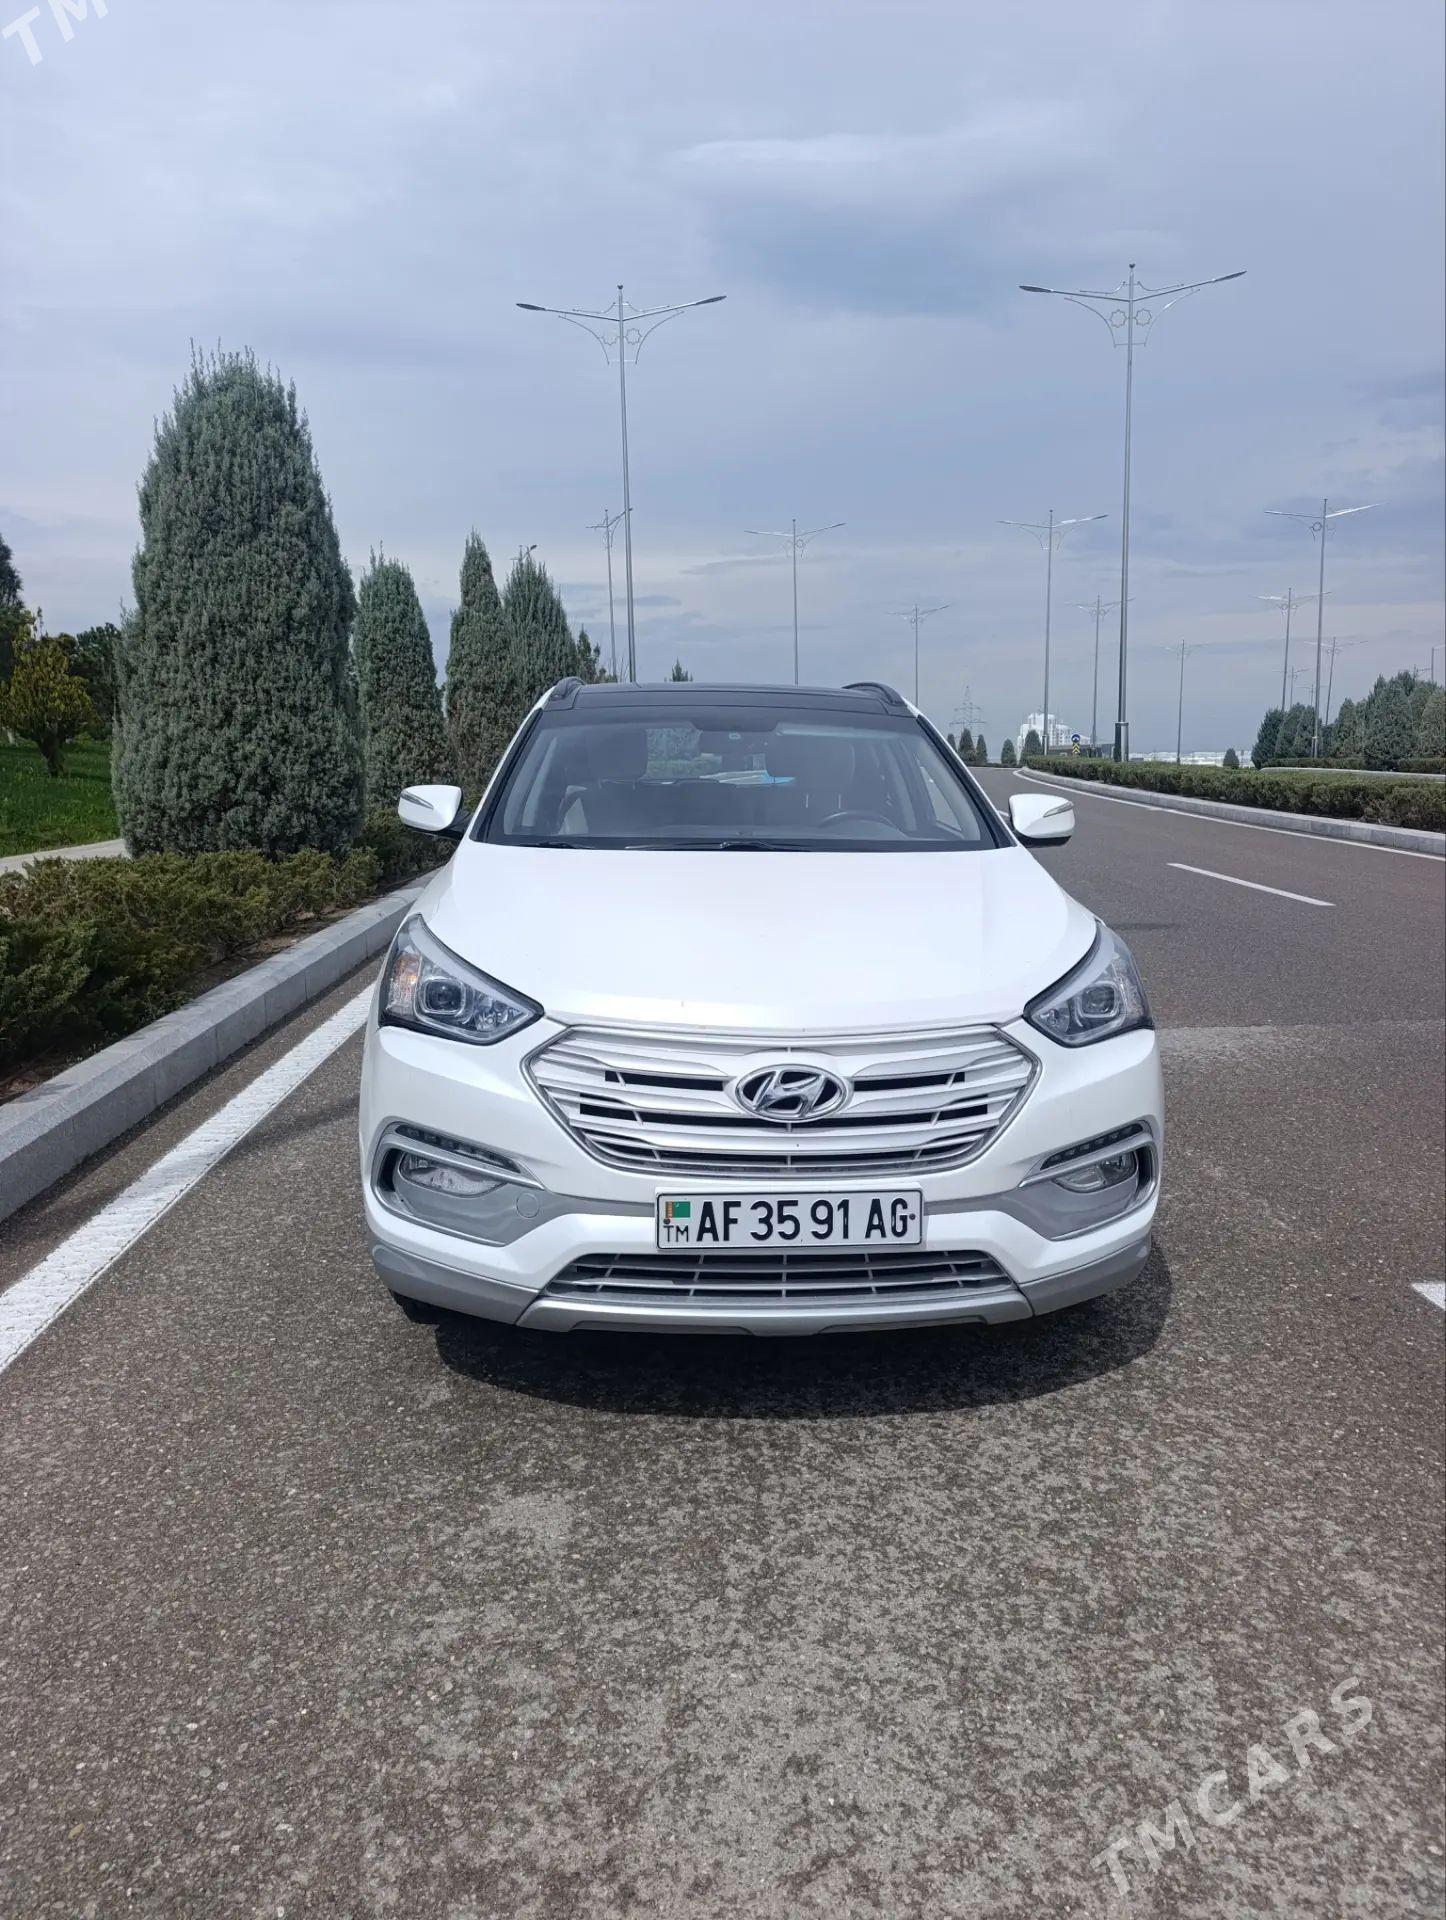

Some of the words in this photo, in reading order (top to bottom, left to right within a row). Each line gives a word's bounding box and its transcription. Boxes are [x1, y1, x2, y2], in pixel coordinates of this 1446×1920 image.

[663, 1225, 689, 1243] TM
[696, 1200, 742, 1242] AF
[864, 1198, 908, 1239] AG
